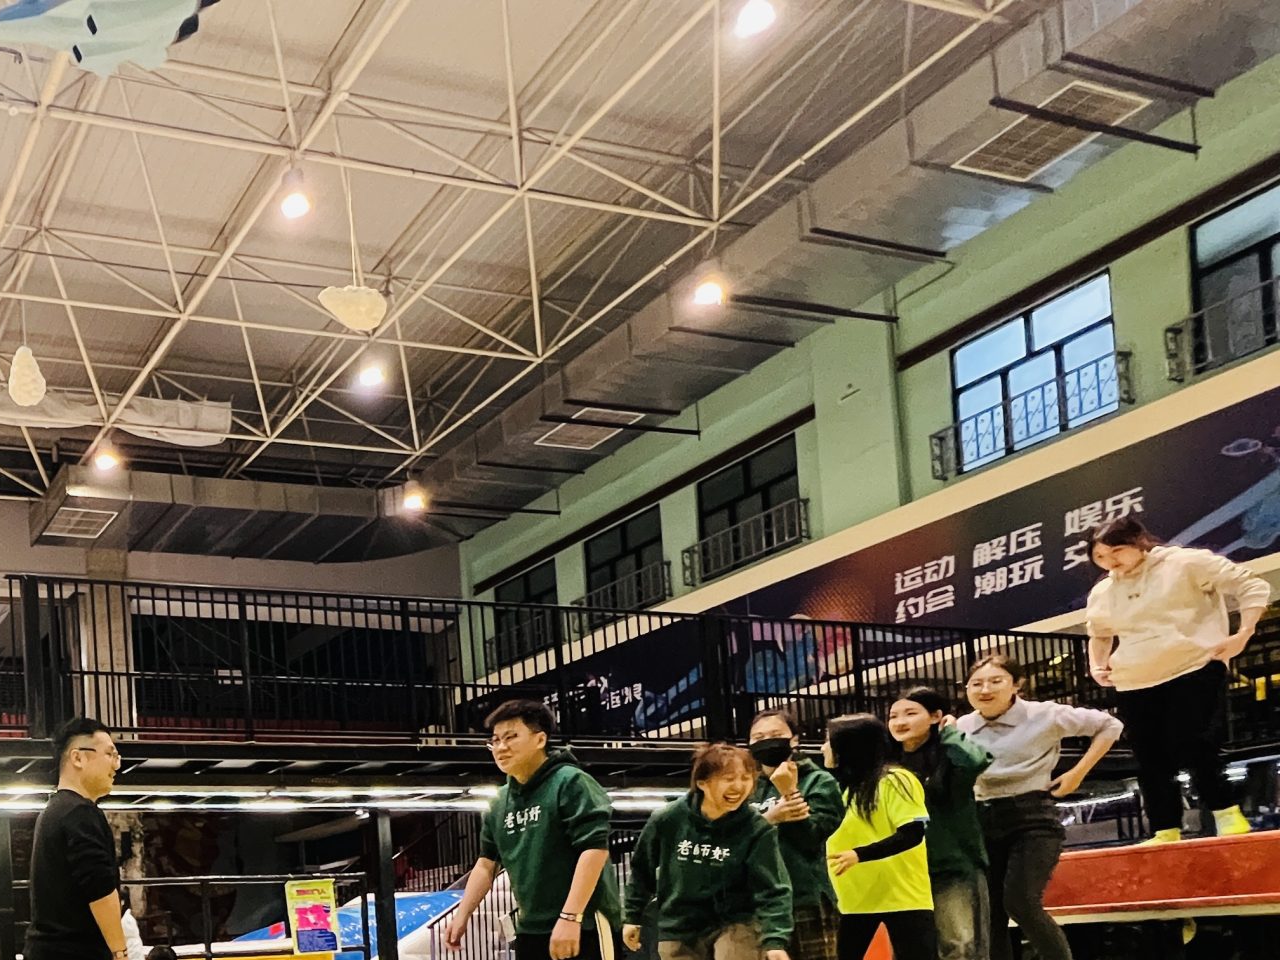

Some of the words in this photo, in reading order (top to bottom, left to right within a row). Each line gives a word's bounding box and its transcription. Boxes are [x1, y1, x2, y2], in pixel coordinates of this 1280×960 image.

[894, 555, 955, 595] 运动
[972, 522, 1043, 568] 解压
[1064, 486, 1144, 537] 娱乐
[895, 584, 955, 624] 约会
[974, 554, 1044, 598] 潮玩
